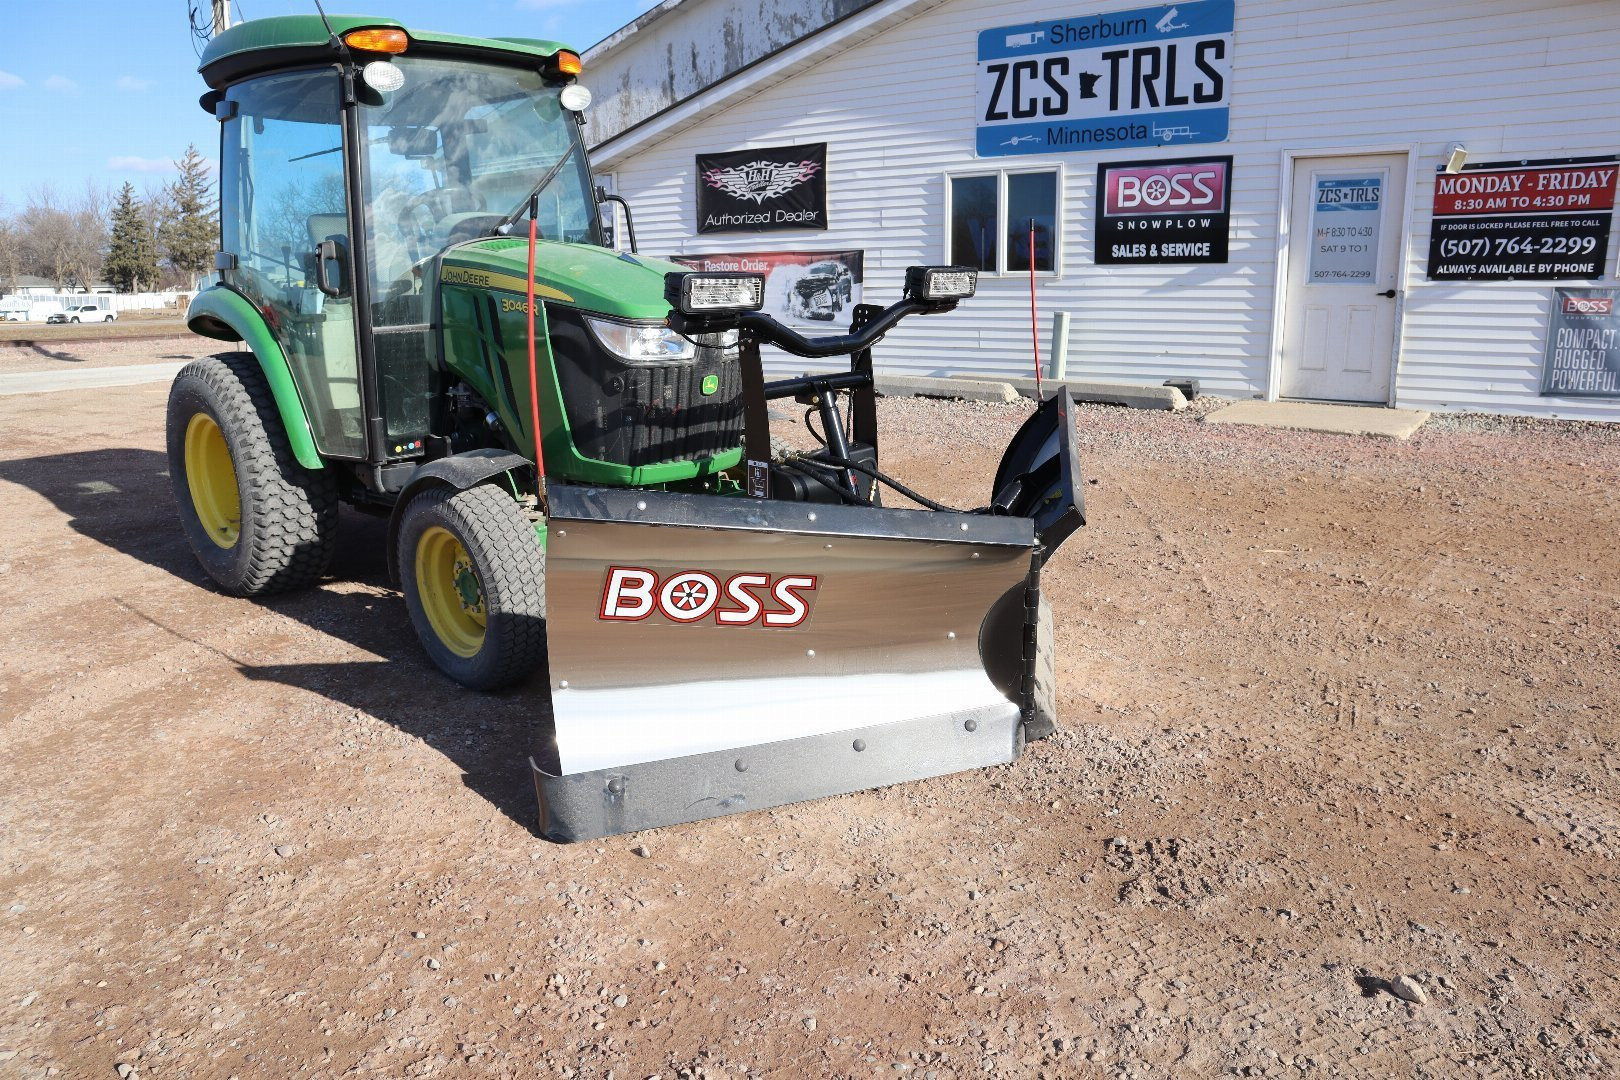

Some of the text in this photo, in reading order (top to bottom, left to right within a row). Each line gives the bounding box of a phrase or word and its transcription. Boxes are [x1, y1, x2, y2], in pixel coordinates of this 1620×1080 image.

[1050, 18, 1147, 46] Sherburn
[985, 39, 1226, 122] ZCS TRLS
[1047, 122, 1148, 146] Minnesota
[1118, 171, 1216, 208] BOSS
[1438, 174, 1526, 195] MONDAY
[1536, 170, 1614, 190] FRIDAY
[1319, 187, 1380, 203] ZCS TRLS
[1454, 194, 1590, 210] 8:30 AM TO 4:30 PM
[705, 209, 819, 225] Authorized Dealer
[1117, 218, 1211, 230] SNOWPLOW
[1318, 227, 1330, 237] M-F
[1347, 227, 1356, 236] TO
[1112, 242, 1210, 257] SALES & SERVICE
[1440, 236, 1596, 258] (507) 764-2299
[704, 258, 770, 272] Restore Order.
[1437, 263, 1594, 274] ALWAYS AVAILABLE BY PHONE
[444, 268, 490, 286] JOHN DEERE
[1567, 300, 1608, 312] BOSS
[1557, 328, 1618, 350] COMPACT.
[1554, 349, 1608, 370] RUGGED.
[599, 565, 818, 628] BOSS
